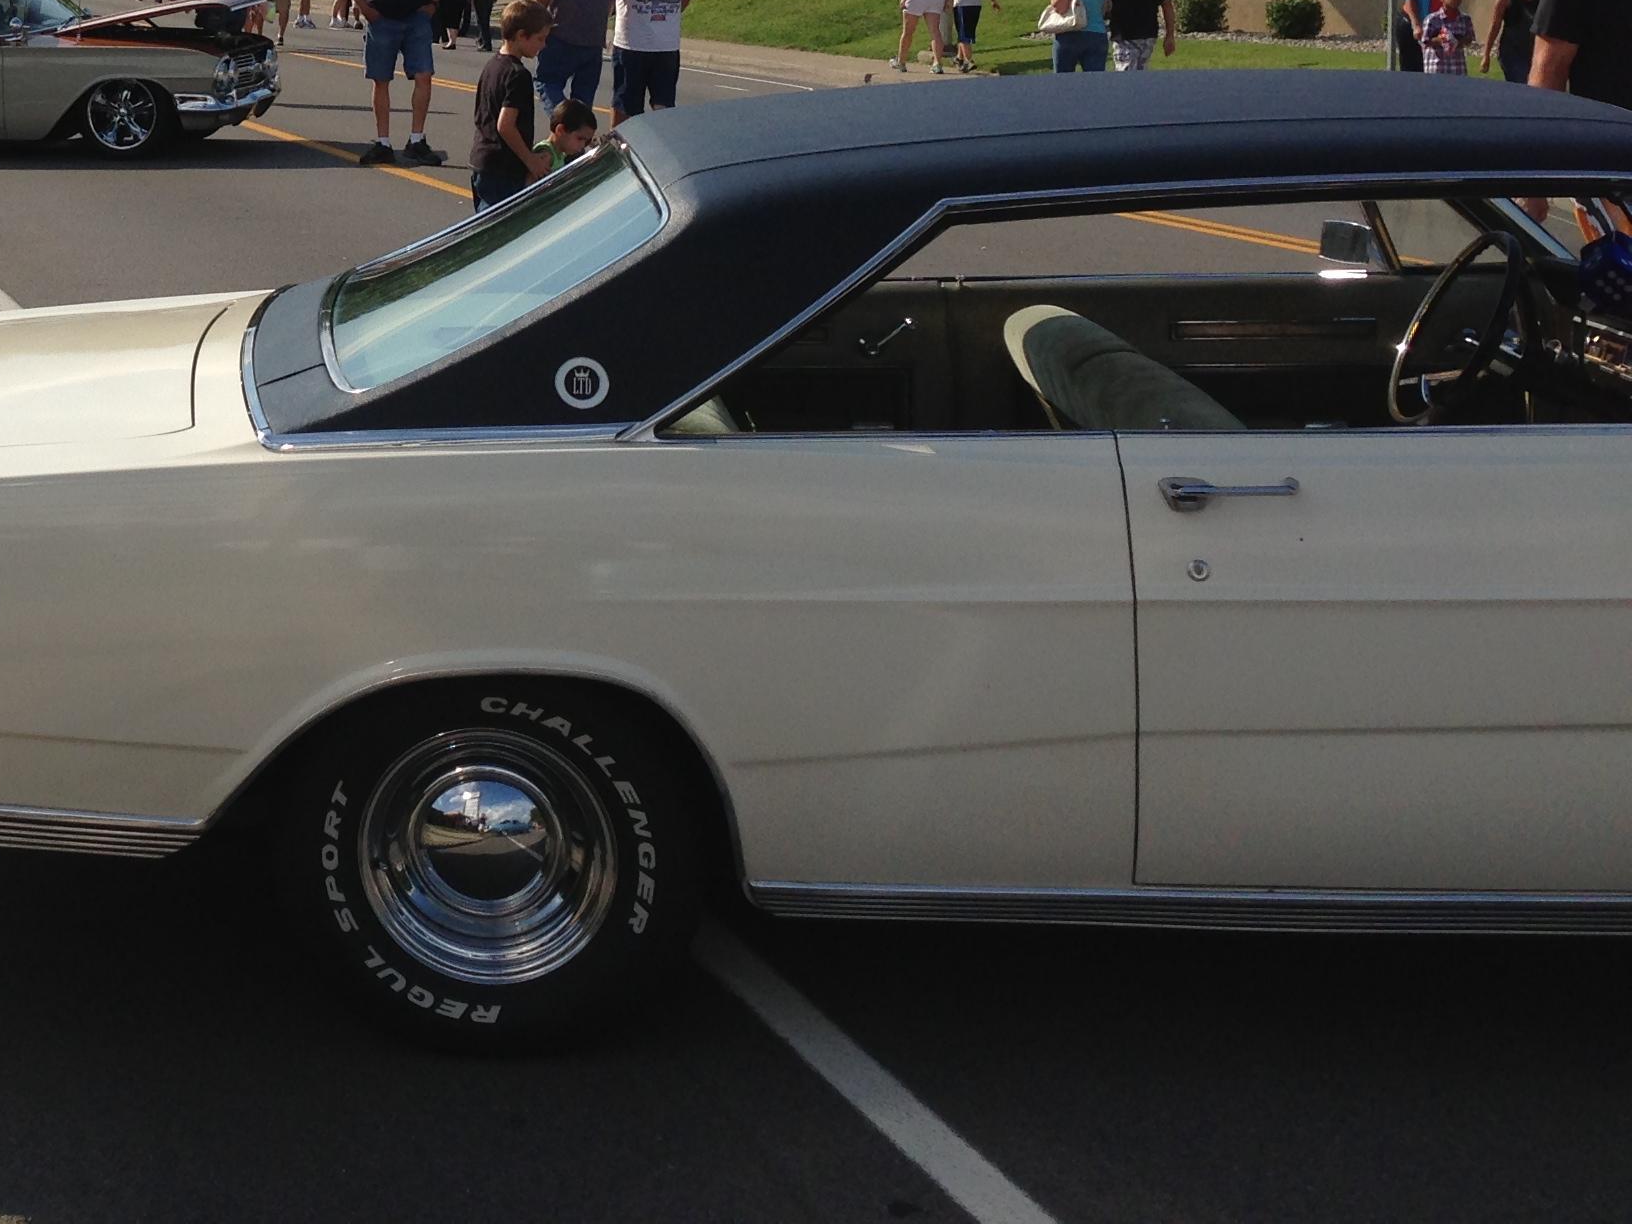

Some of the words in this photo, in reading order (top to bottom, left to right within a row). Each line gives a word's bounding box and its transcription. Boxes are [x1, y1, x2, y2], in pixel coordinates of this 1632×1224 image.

[572, 377, 592, 395] LTD
[321, 780, 360, 933] SPORT
[479, 696, 657, 935] CHALLENGER
[363, 944, 503, 1025] REGUL
